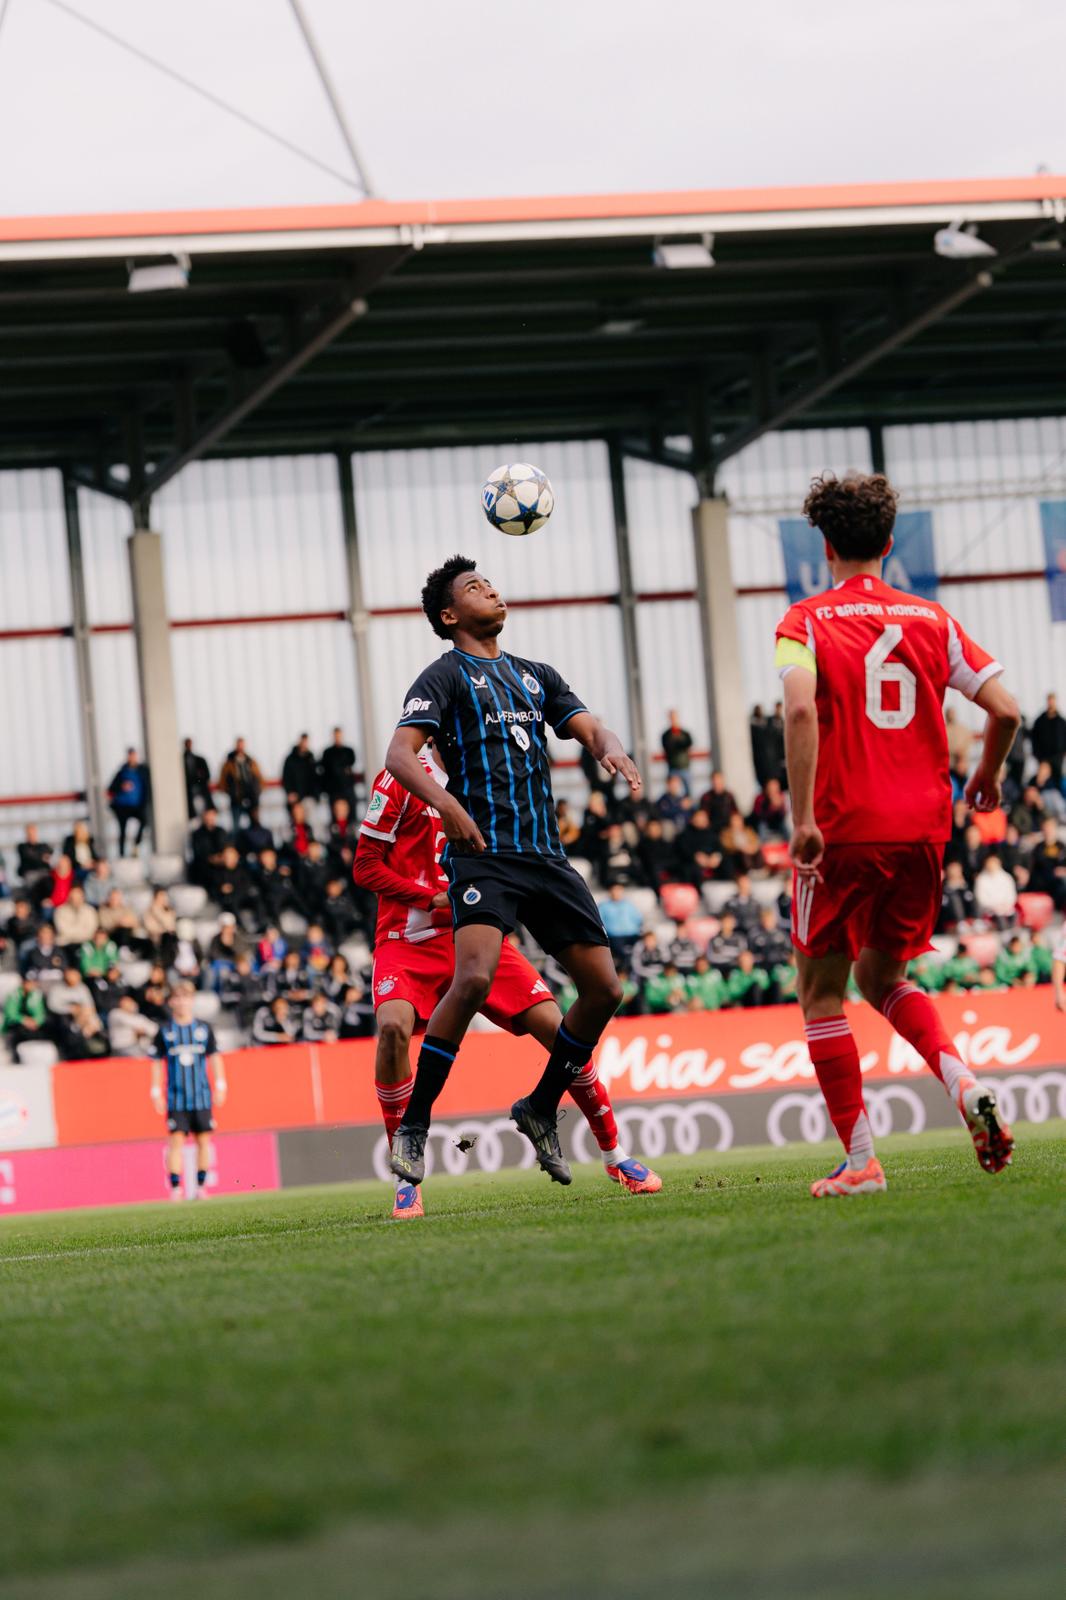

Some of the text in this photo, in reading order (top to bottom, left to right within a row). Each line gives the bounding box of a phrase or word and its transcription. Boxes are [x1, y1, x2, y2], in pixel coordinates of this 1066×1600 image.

[816, 606, 834, 620] FC
[864, 623, 917, 729] 6
[598, 1033, 726, 1092] Mia
[728, 1041, 879, 1088] sa
